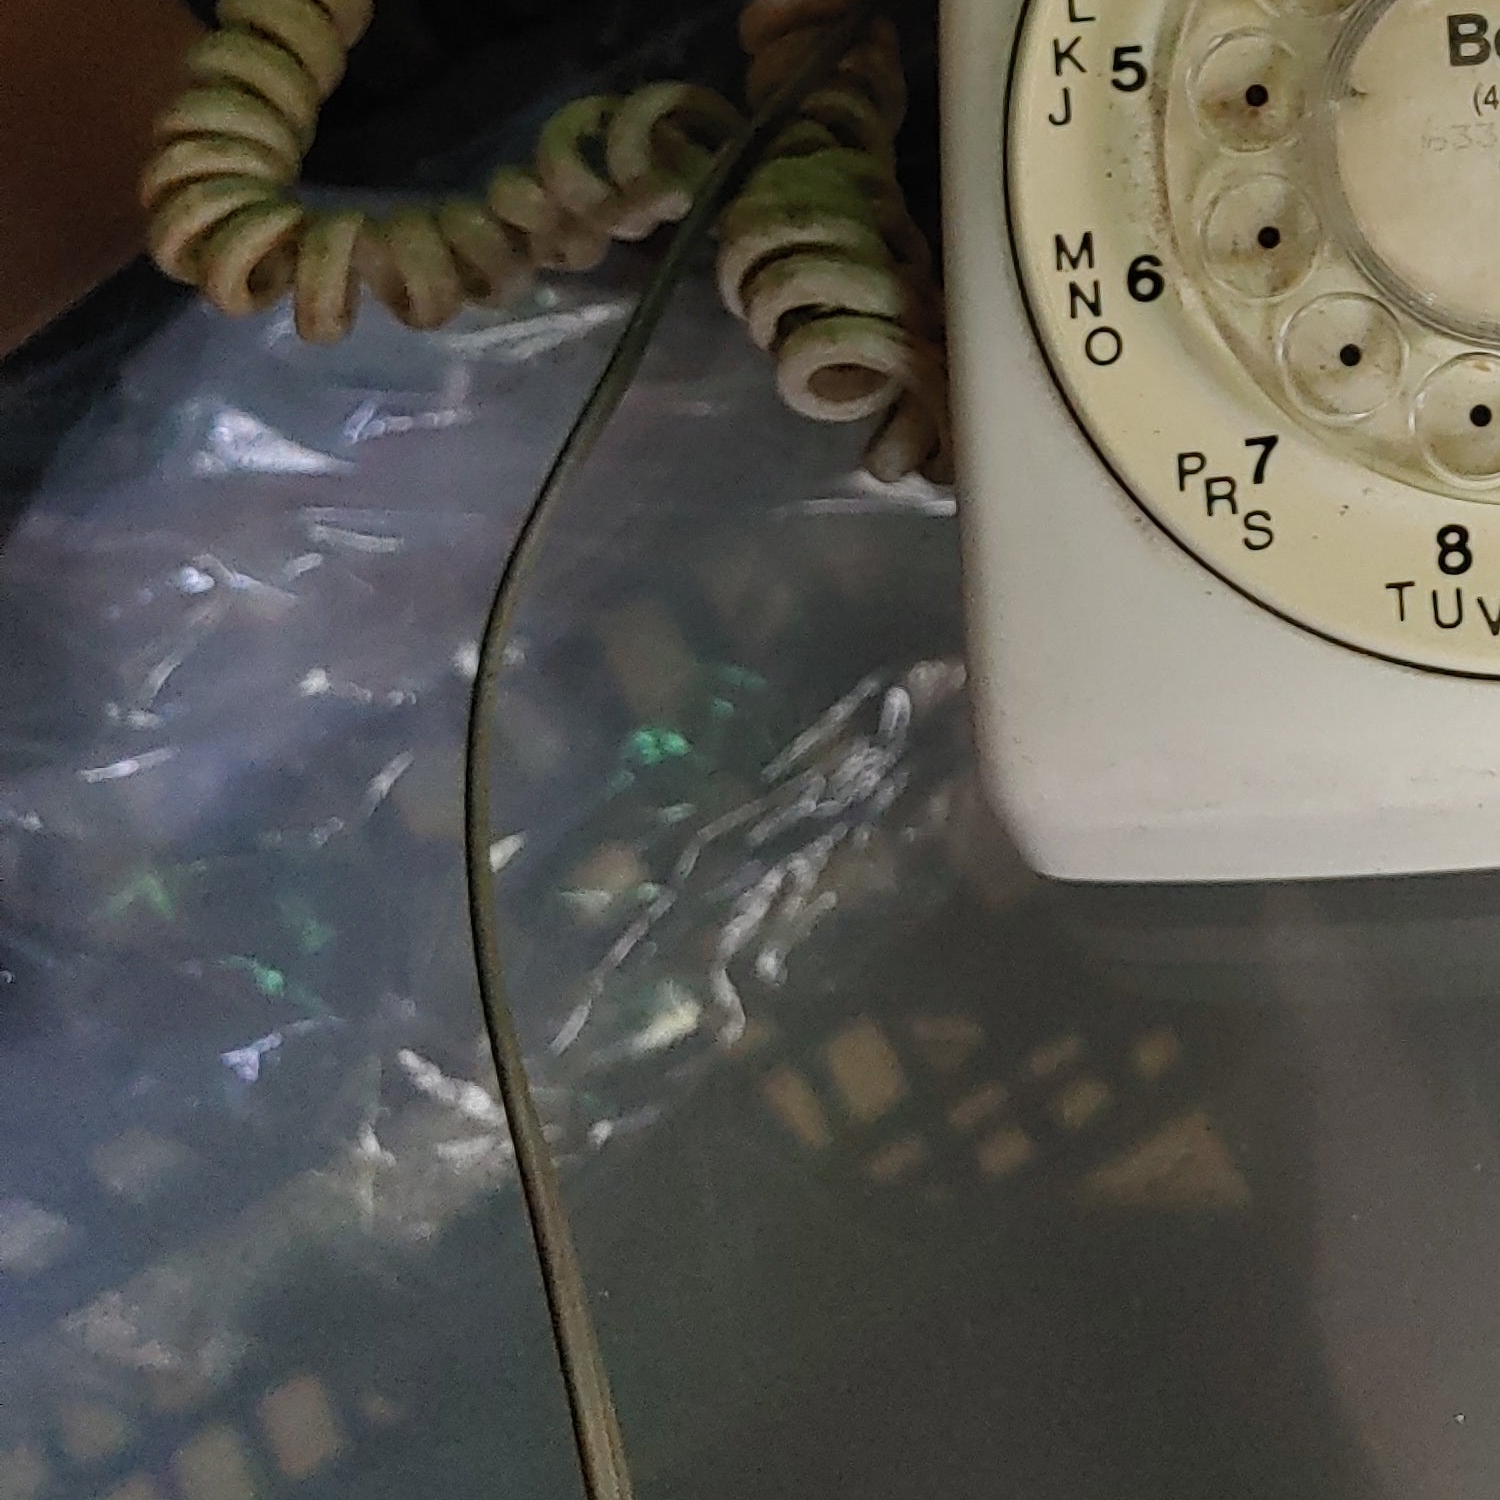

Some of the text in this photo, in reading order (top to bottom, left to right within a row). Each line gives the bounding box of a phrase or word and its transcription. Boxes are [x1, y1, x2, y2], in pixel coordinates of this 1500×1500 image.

[1111, 45, 1147, 92] 5
[1055, 231, 1123, 366] MNO
[1126, 254, 1165, 302] 6
[1245, 435, 1279, 484] 7
[1177, 452, 1274, 551] PRS
[1436, 524, 1473, 575] 8
